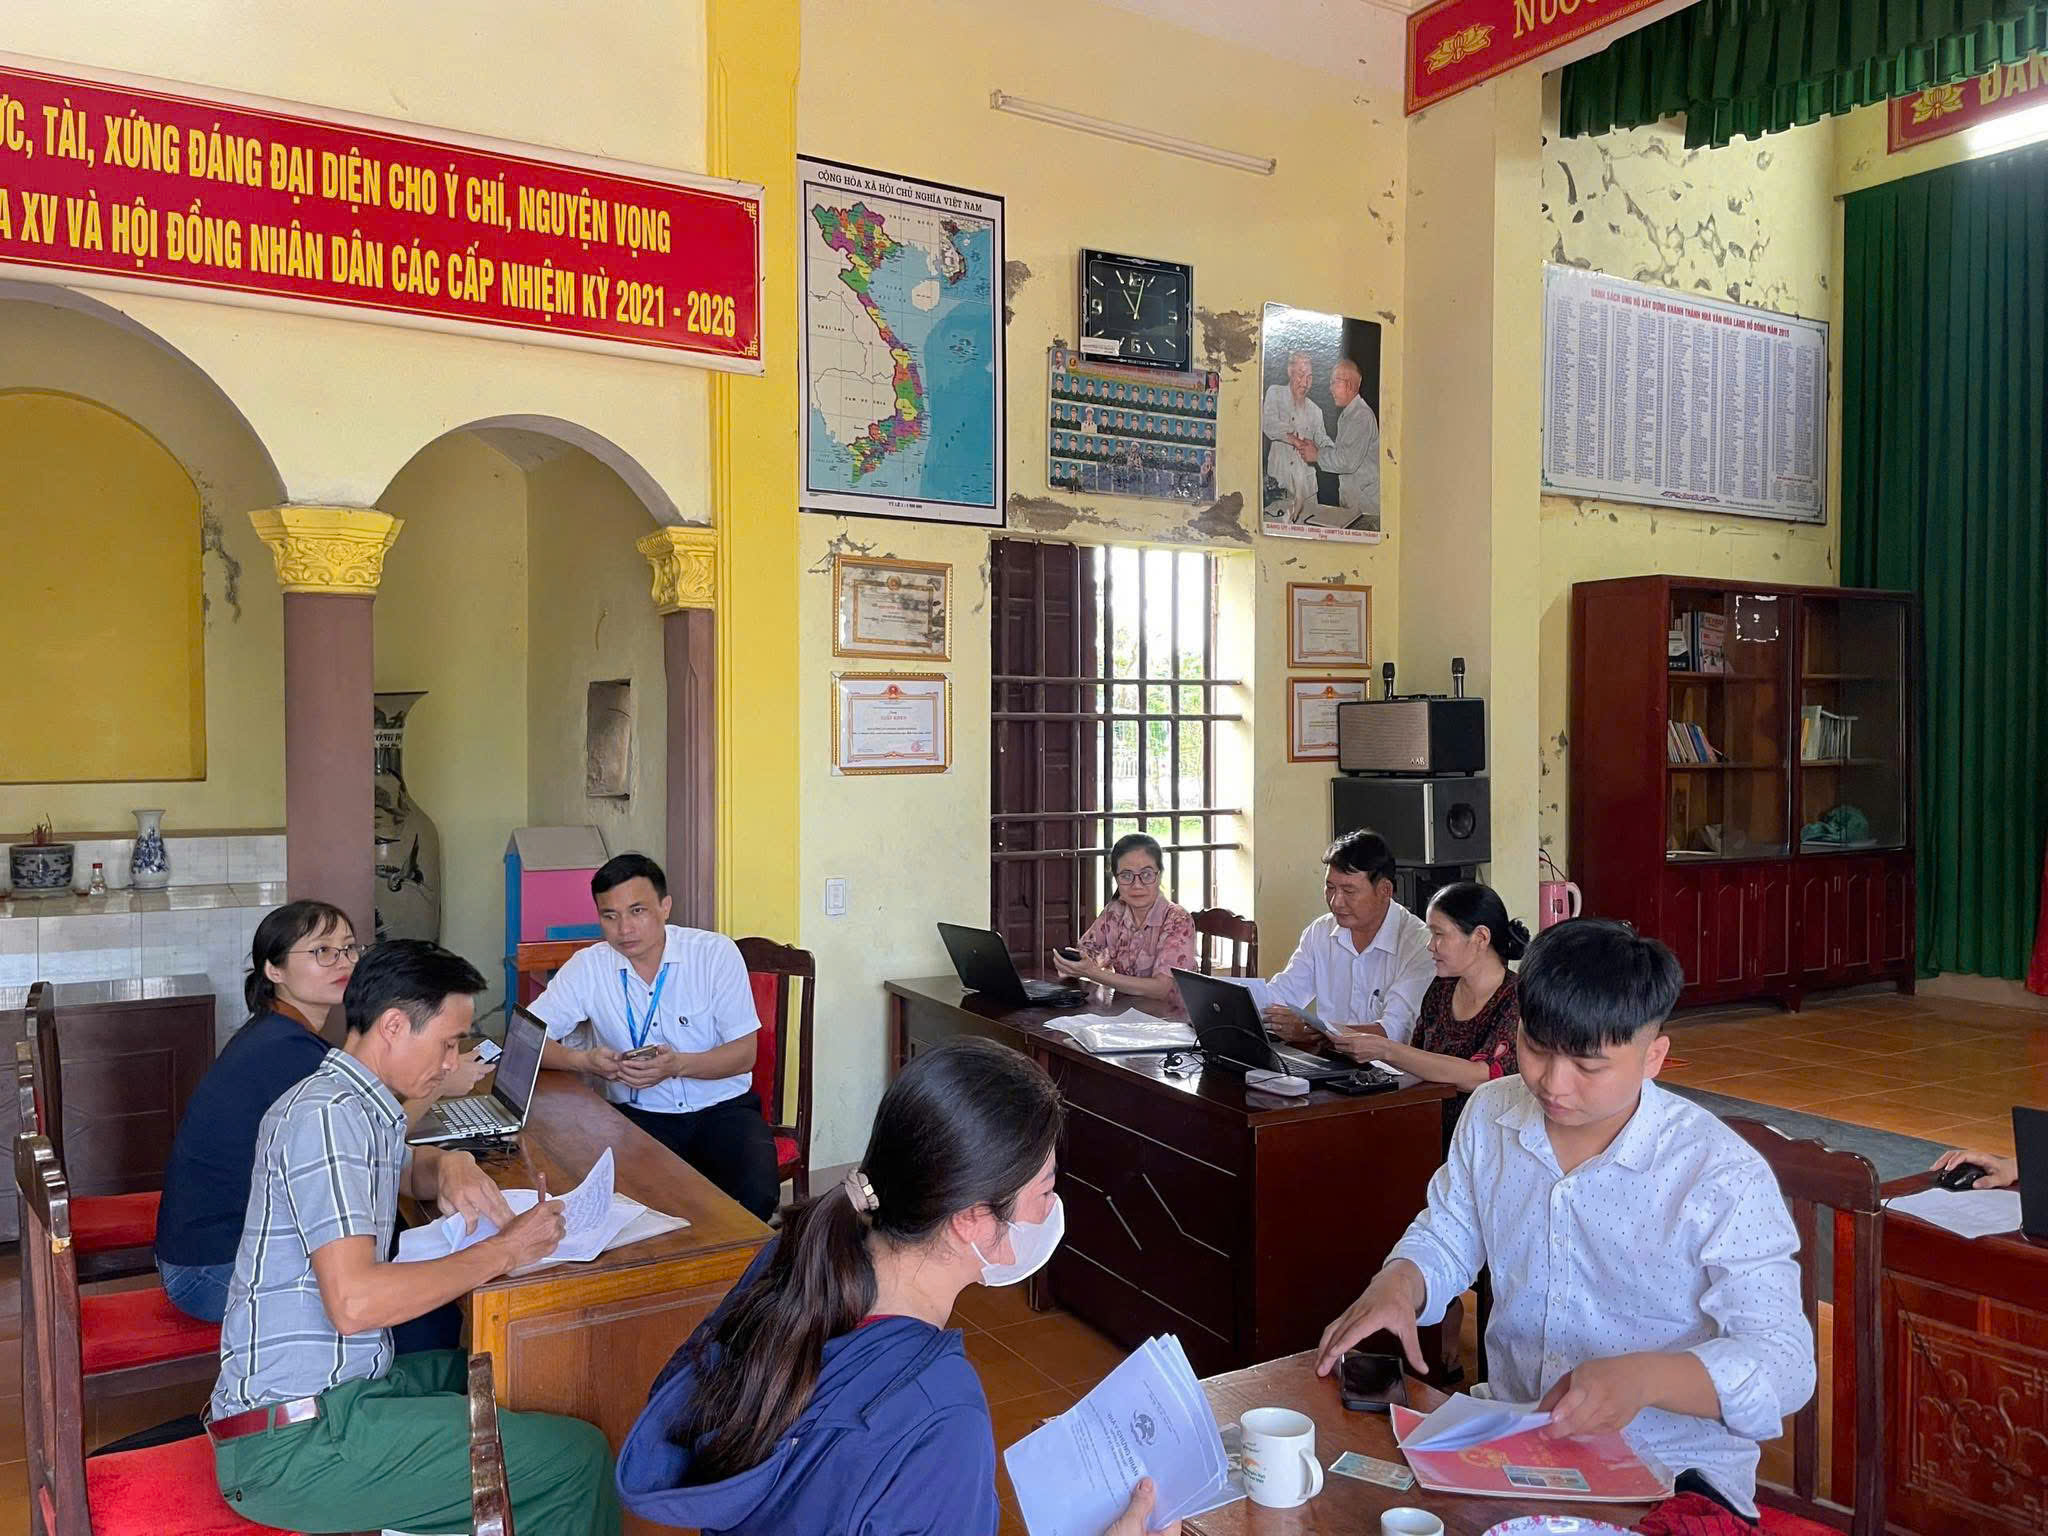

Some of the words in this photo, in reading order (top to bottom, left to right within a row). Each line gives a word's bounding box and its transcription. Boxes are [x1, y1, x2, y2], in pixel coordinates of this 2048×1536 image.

[43, 98, 95, 168] TÀI,
[104, 109, 180, 174] XỨNG
[188, 123, 262, 187] ĐÁNG
[269, 142, 314, 204] ĐẠI
[322, 147, 380, 214] DIỆN
[388, 163, 437, 215] CHO
[445, 164, 459, 219] Ý
[466, 173, 512, 233] CHÍ,
[519, 186, 608, 250] NGUYỆN
[613, 203, 671, 258] VỌNG
[818, 170, 841, 183] CỘNG
[844, 176, 862, 188] HÒA
[879, 183, 894, 195] HỘI
[896, 186, 913, 198] CHỦ
[944, 196, 962, 208] VIỆT
[964, 201, 982, 212] NAM
[21, 191, 58, 245] XV
[66, 189, 103, 251] VÀ
[112, 196, 158, 268] HỘI
[167, 199, 242, 269] ĐỒNG
[250, 219, 324, 281] NHÂN
[331, 229, 384, 289] DÂN
[392, 238, 440, 297] CÁC
[448, 241, 495, 303] CẤP
[501, 259, 576, 322] NHIỆM
[582, 267, 610, 320] KỲ
[616, 279, 664, 328] 2021
[673, 307, 681, 317] -
[687, 290, 736, 338] 2026
